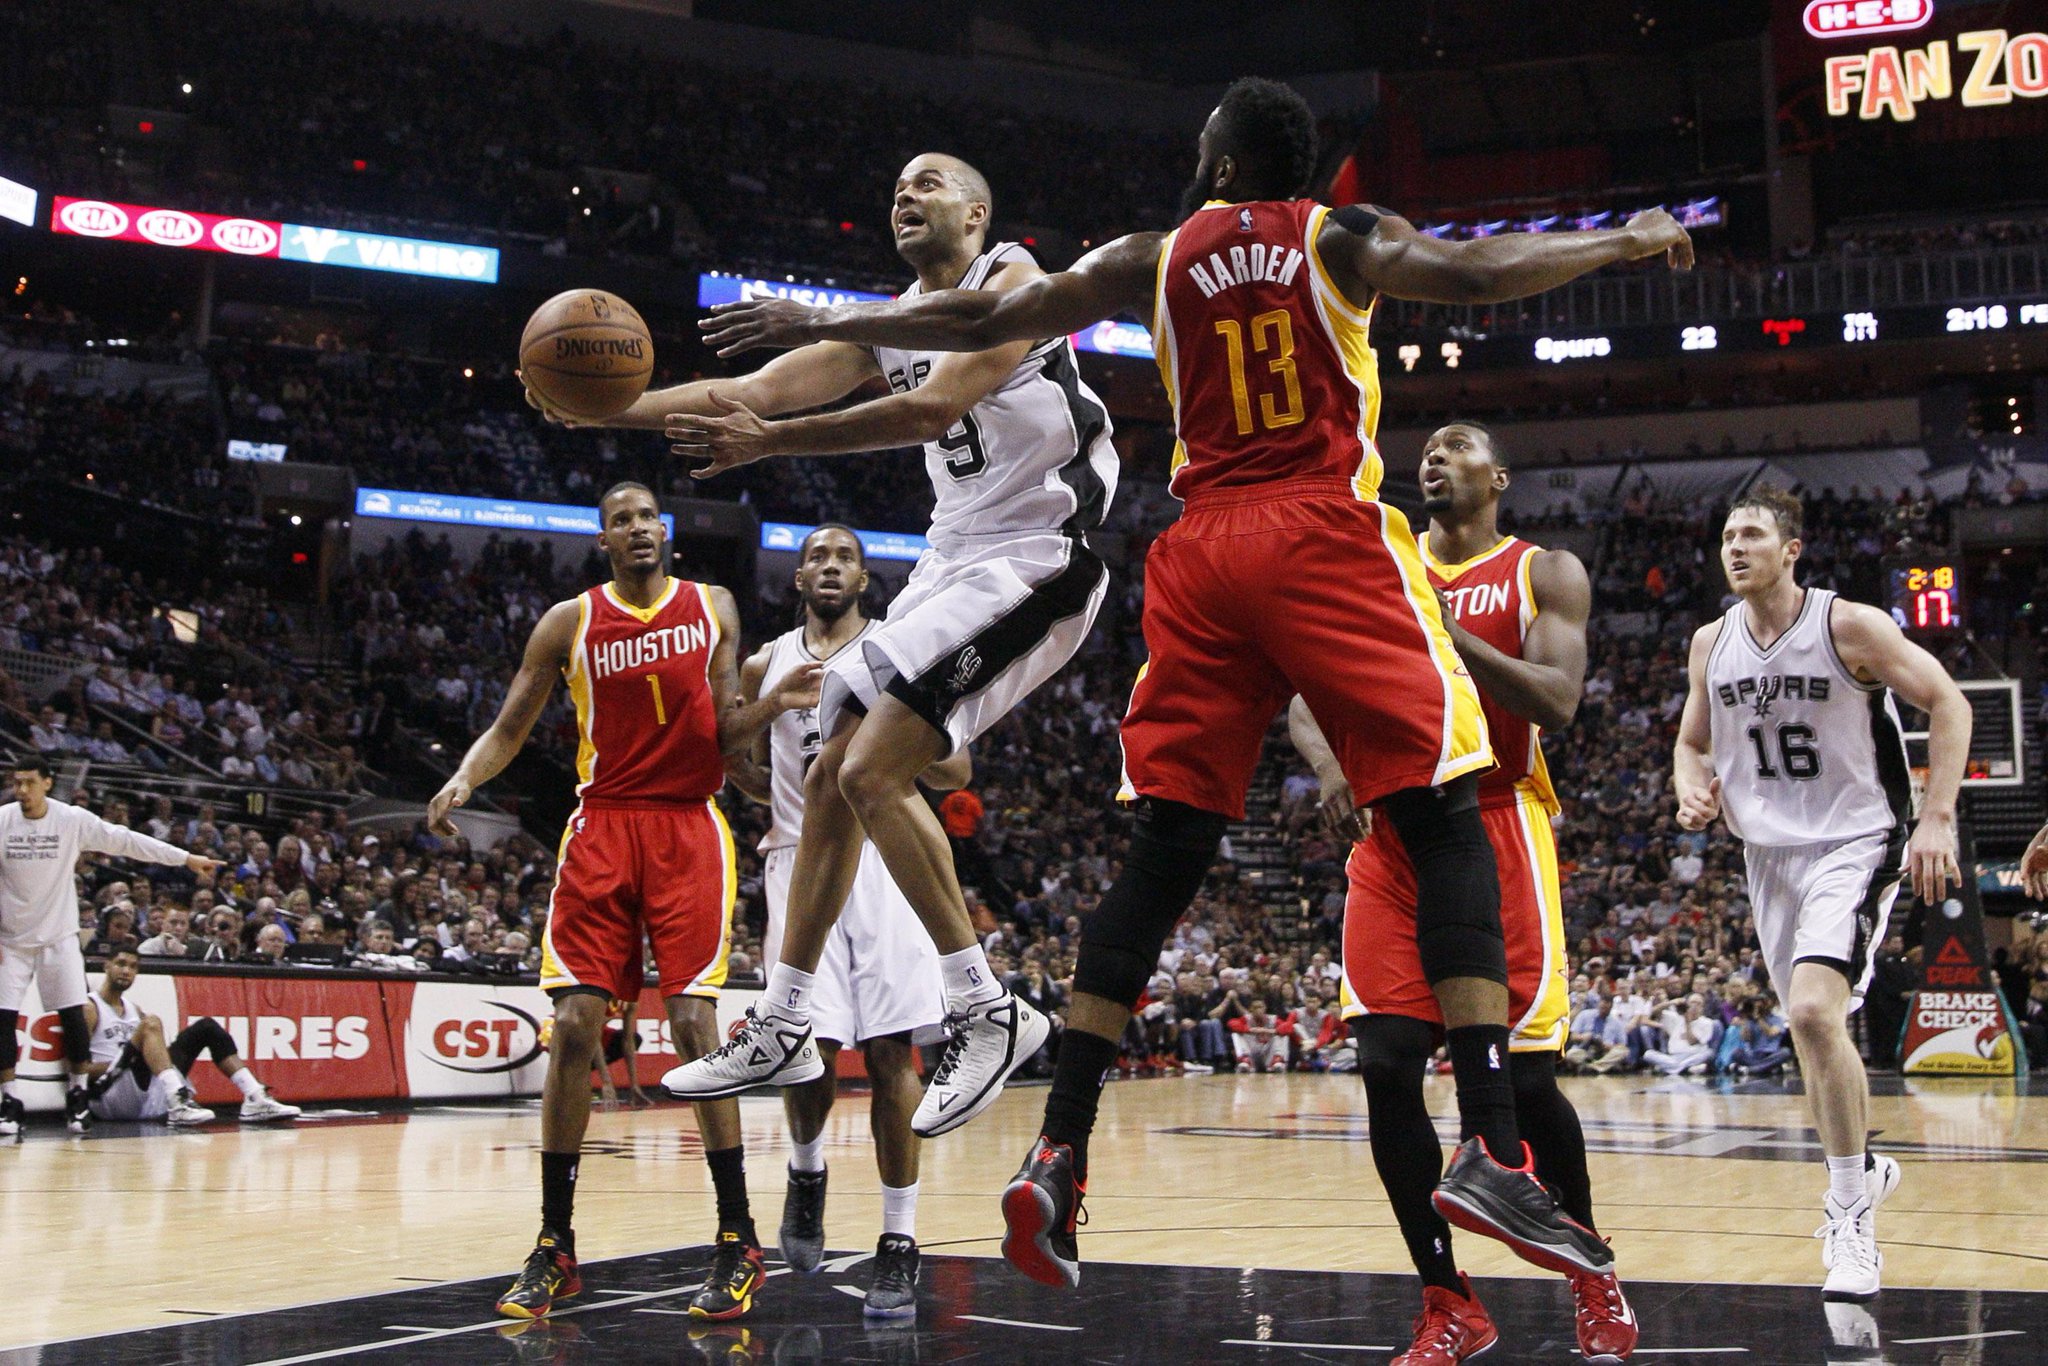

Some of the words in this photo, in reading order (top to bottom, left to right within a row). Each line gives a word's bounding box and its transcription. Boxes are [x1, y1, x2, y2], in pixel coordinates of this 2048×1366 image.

[1825, 40, 1952, 121] FAN
[70, 208, 118, 231] KIA
[147, 216, 193, 239] KIA
[221, 225, 266, 248] KIA
[356, 238, 487, 277] VALERO
[1188, 243, 1304, 299] HARDEN
[555, 337, 643, 359] SPALDING
[1535, 337, 1611, 363] Spurs
[1682, 325, 1718, 350] 22
[1214, 309, 1305, 435] 13
[936, 411, 988, 481] 9
[1908, 567, 1953, 590] 2:18
[1917, 591, 1949, 627] 17
[594, 618, 706, 679] HOUSTON
[646, 674, 666, 725] 1
[1718, 675, 1830, 718] SPURS
[1746, 722, 1821, 780] 16
[1927, 966, 1983, 985] PEAK
[1917, 1011, 1998, 1028] CHECK
[1919, 993, 1997, 1010] BRAKE
[433, 1020, 518, 1057] CST
